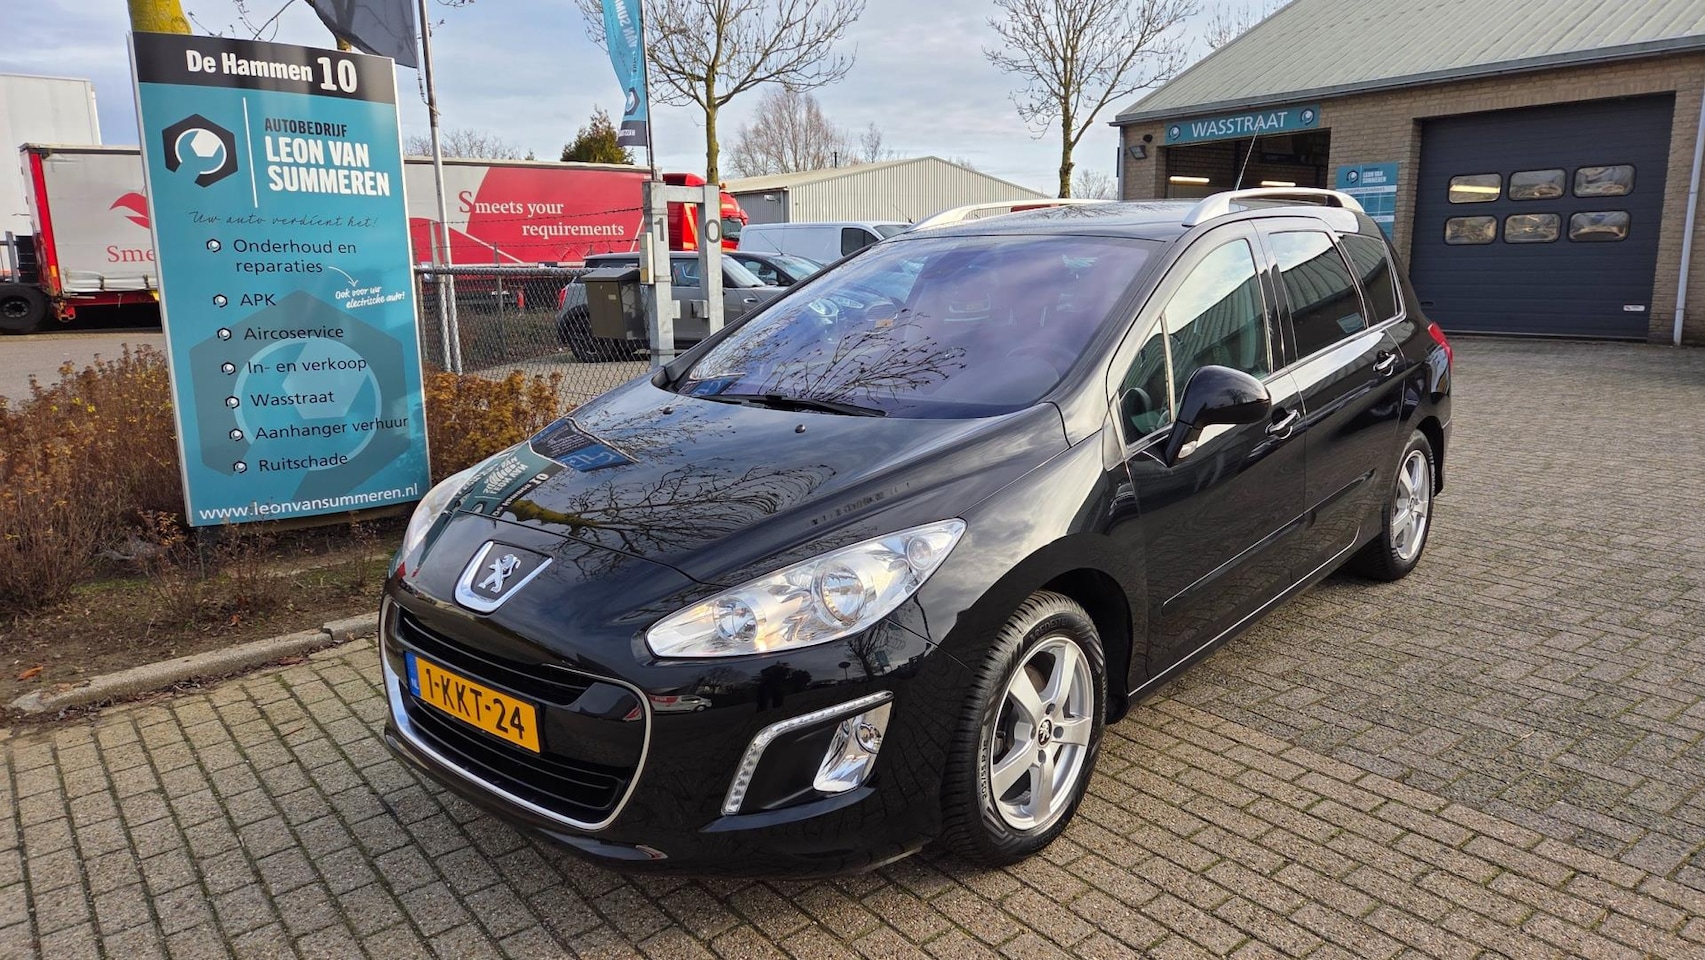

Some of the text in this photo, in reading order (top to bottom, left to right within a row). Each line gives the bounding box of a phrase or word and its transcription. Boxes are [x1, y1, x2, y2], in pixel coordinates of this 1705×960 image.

[185, 49, 358, 94] De Hammen 10
[264, 117, 347, 138] AUTOBEDRIJF
[1191, 111, 1288, 138] WASSTRAAT
[265, 135, 370, 168] LEON VAN
[267, 166, 390, 197] SUMMEREN
[458, 190, 564, 219] Smeets your
[189, 210, 378, 228] Uw auto verdient het!
[522, 222, 624, 239] requirements
[654, 217, 665, 242] 1
[233, 239, 357, 255] Onderhoud en
[235, 259, 324, 275] reparaties
[240, 293, 276, 307] APK
[335, 288, 350, 299] Ook
[352, 287, 369, 297] voor
[386, 291, 405, 302] auto!
[243, 326, 344, 341] Aircoservice
[247, 356, 367, 375] In- en verkoop
[250, 391, 335, 407] Wasstraat
[255, 416, 408, 441] Aanhanger verhuur
[258, 453, 348, 473] Ruitschade
[198, 483, 418, 520] www.leonvansummeren.nl
[426, 668, 525, 740] 1-KKT-24
